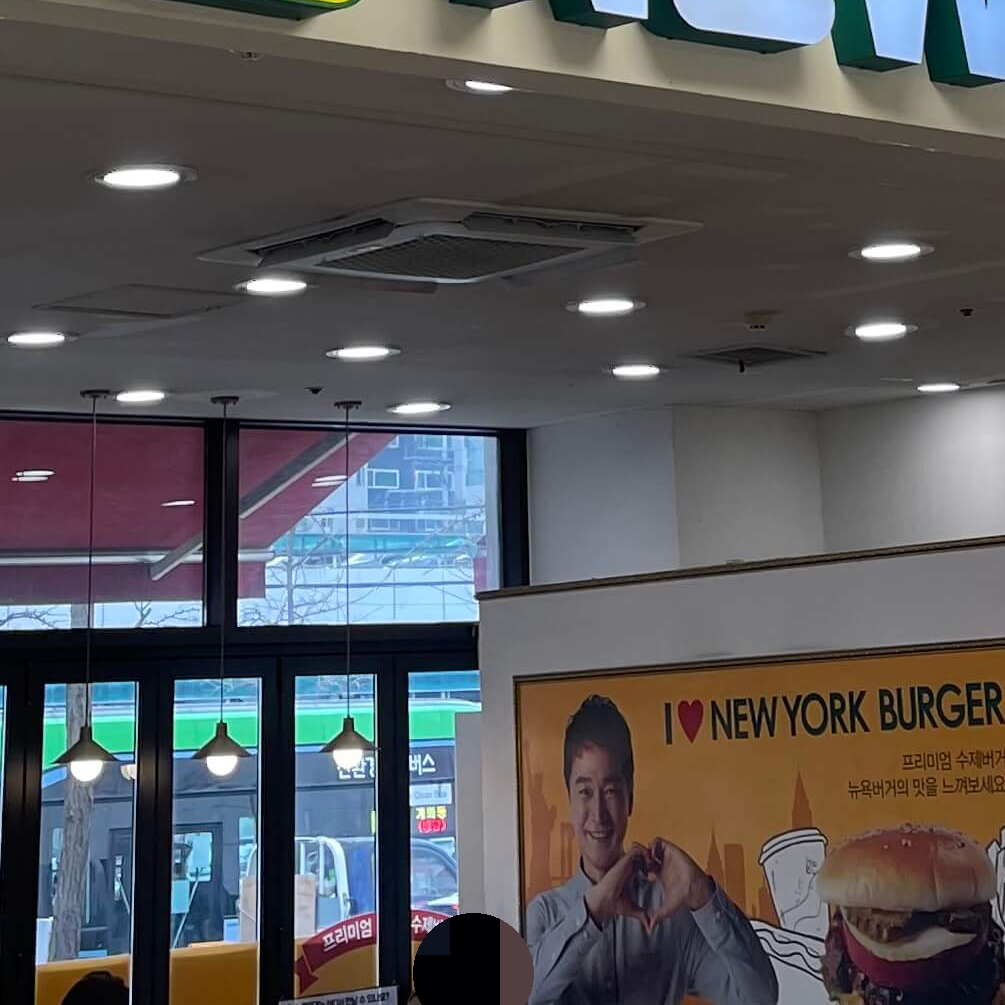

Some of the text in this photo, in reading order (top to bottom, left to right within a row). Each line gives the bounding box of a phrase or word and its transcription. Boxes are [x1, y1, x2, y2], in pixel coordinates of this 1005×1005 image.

[664, 701, 673, 745] I
[902, 751, 951, 772] 프리미엄
[848, 777, 909, 800] 뉴욕버거의
[912, 776, 938, 798] 맛을
[322, 917, 373, 952] 프리미엄
